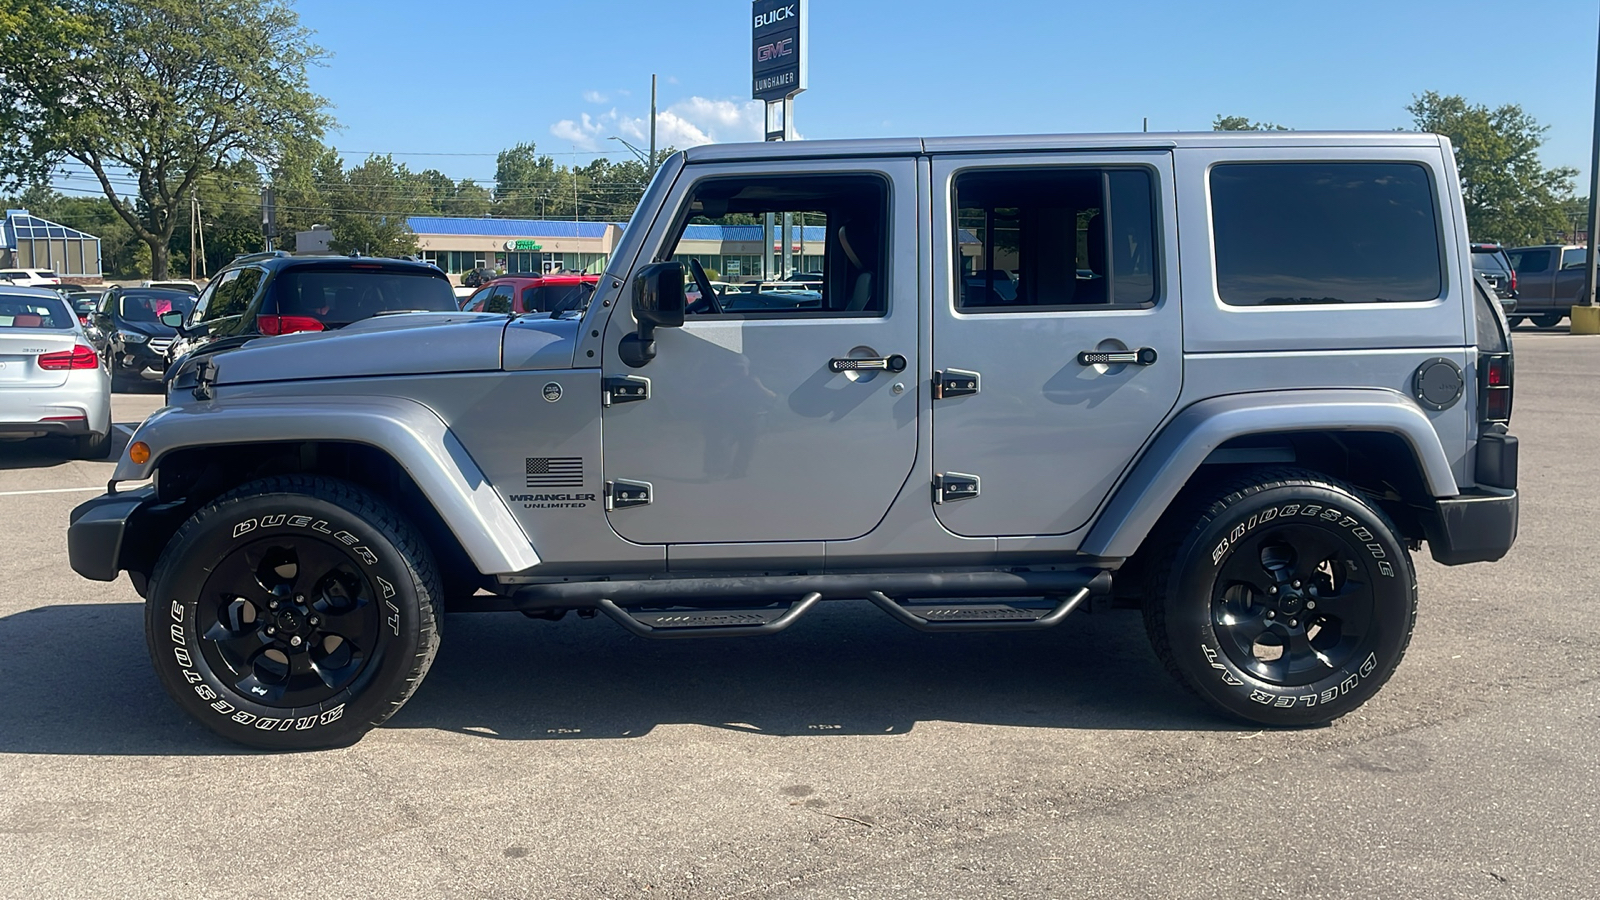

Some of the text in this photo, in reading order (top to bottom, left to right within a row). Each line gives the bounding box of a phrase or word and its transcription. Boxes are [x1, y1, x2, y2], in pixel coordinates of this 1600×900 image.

[754, 4, 795, 28] BUICK
[757, 37, 793, 62] GMC
[755, 72, 794, 91] LUNGHAMER
[509, 493, 596, 502] WRANGLER
[1212, 504, 1394, 578] BRIDGESTONE
[233, 514, 400, 636] DUELER A/T
[171, 600, 346, 731] BRIDGESTONE
[1201, 644, 1378, 708] DUELER A/T
